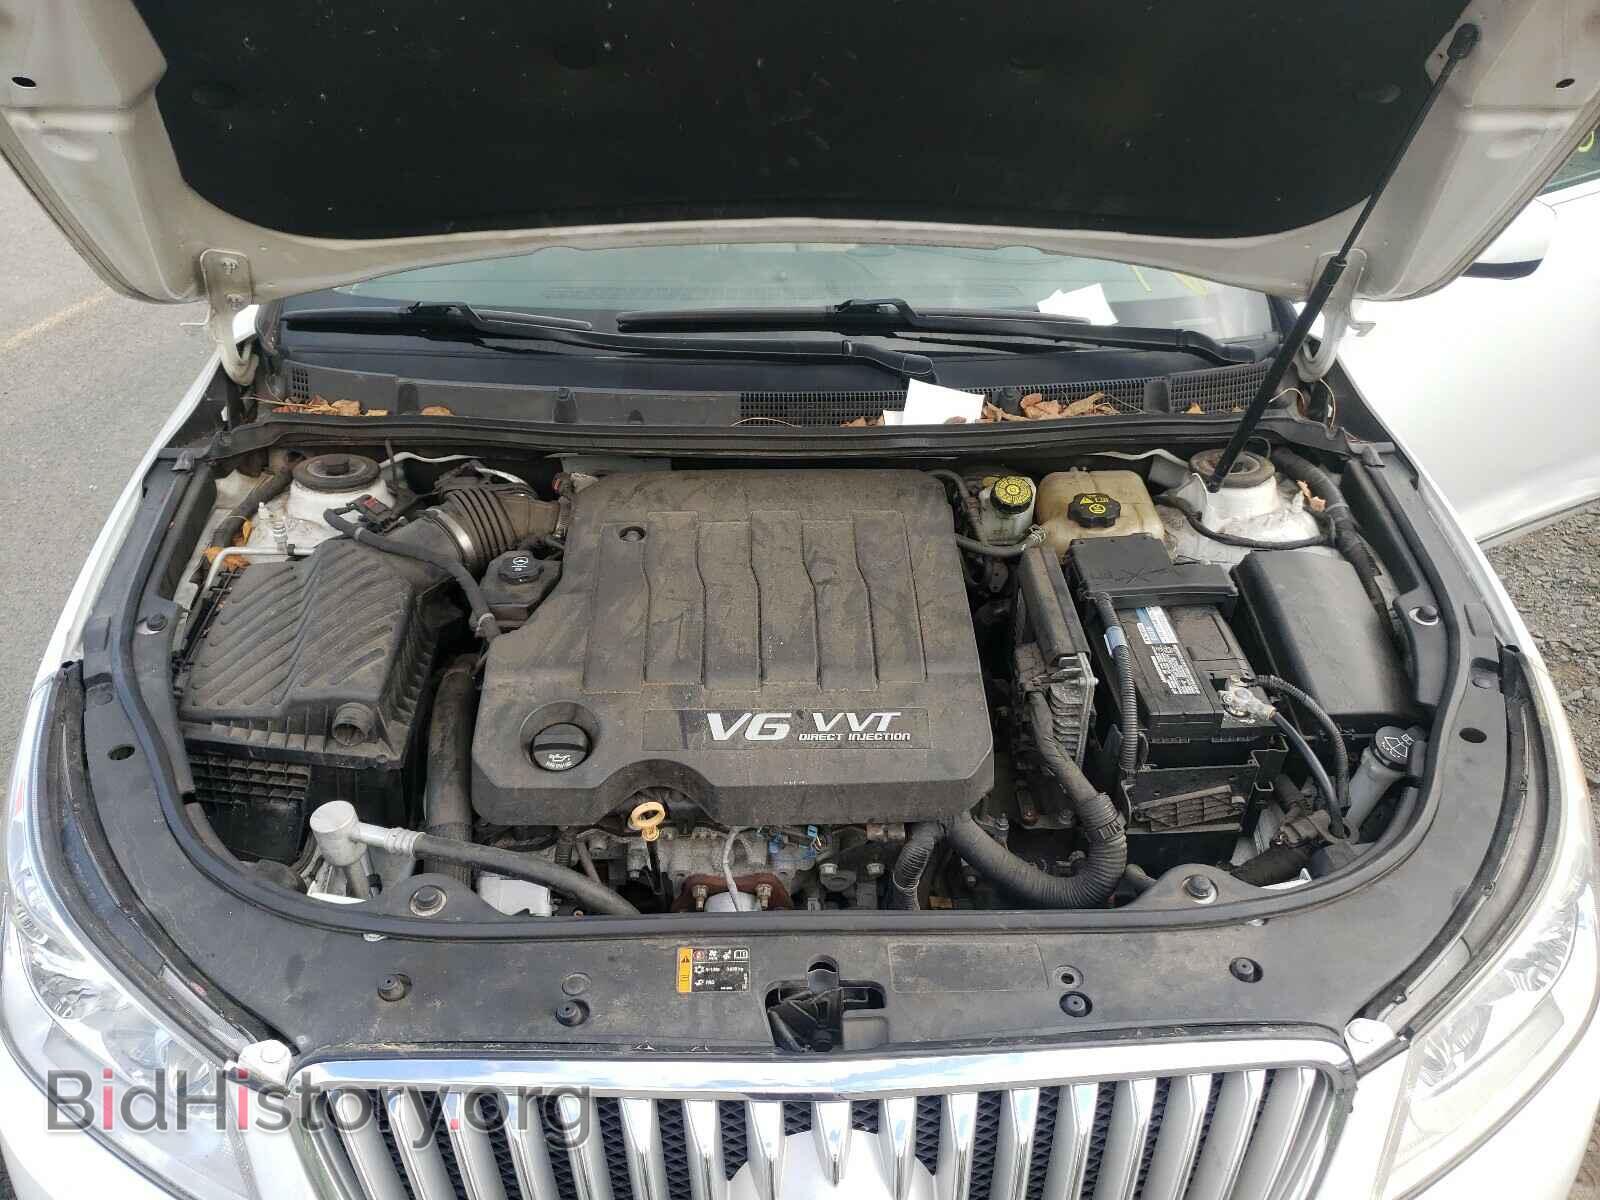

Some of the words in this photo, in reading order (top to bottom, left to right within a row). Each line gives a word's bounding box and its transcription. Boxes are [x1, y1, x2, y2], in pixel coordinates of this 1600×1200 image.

[707, 712, 792, 741] V6
[812, 711, 901, 732] VVT
[798, 733, 844, 741] DIRECT
[848, 732, 911, 741] INJECTION
